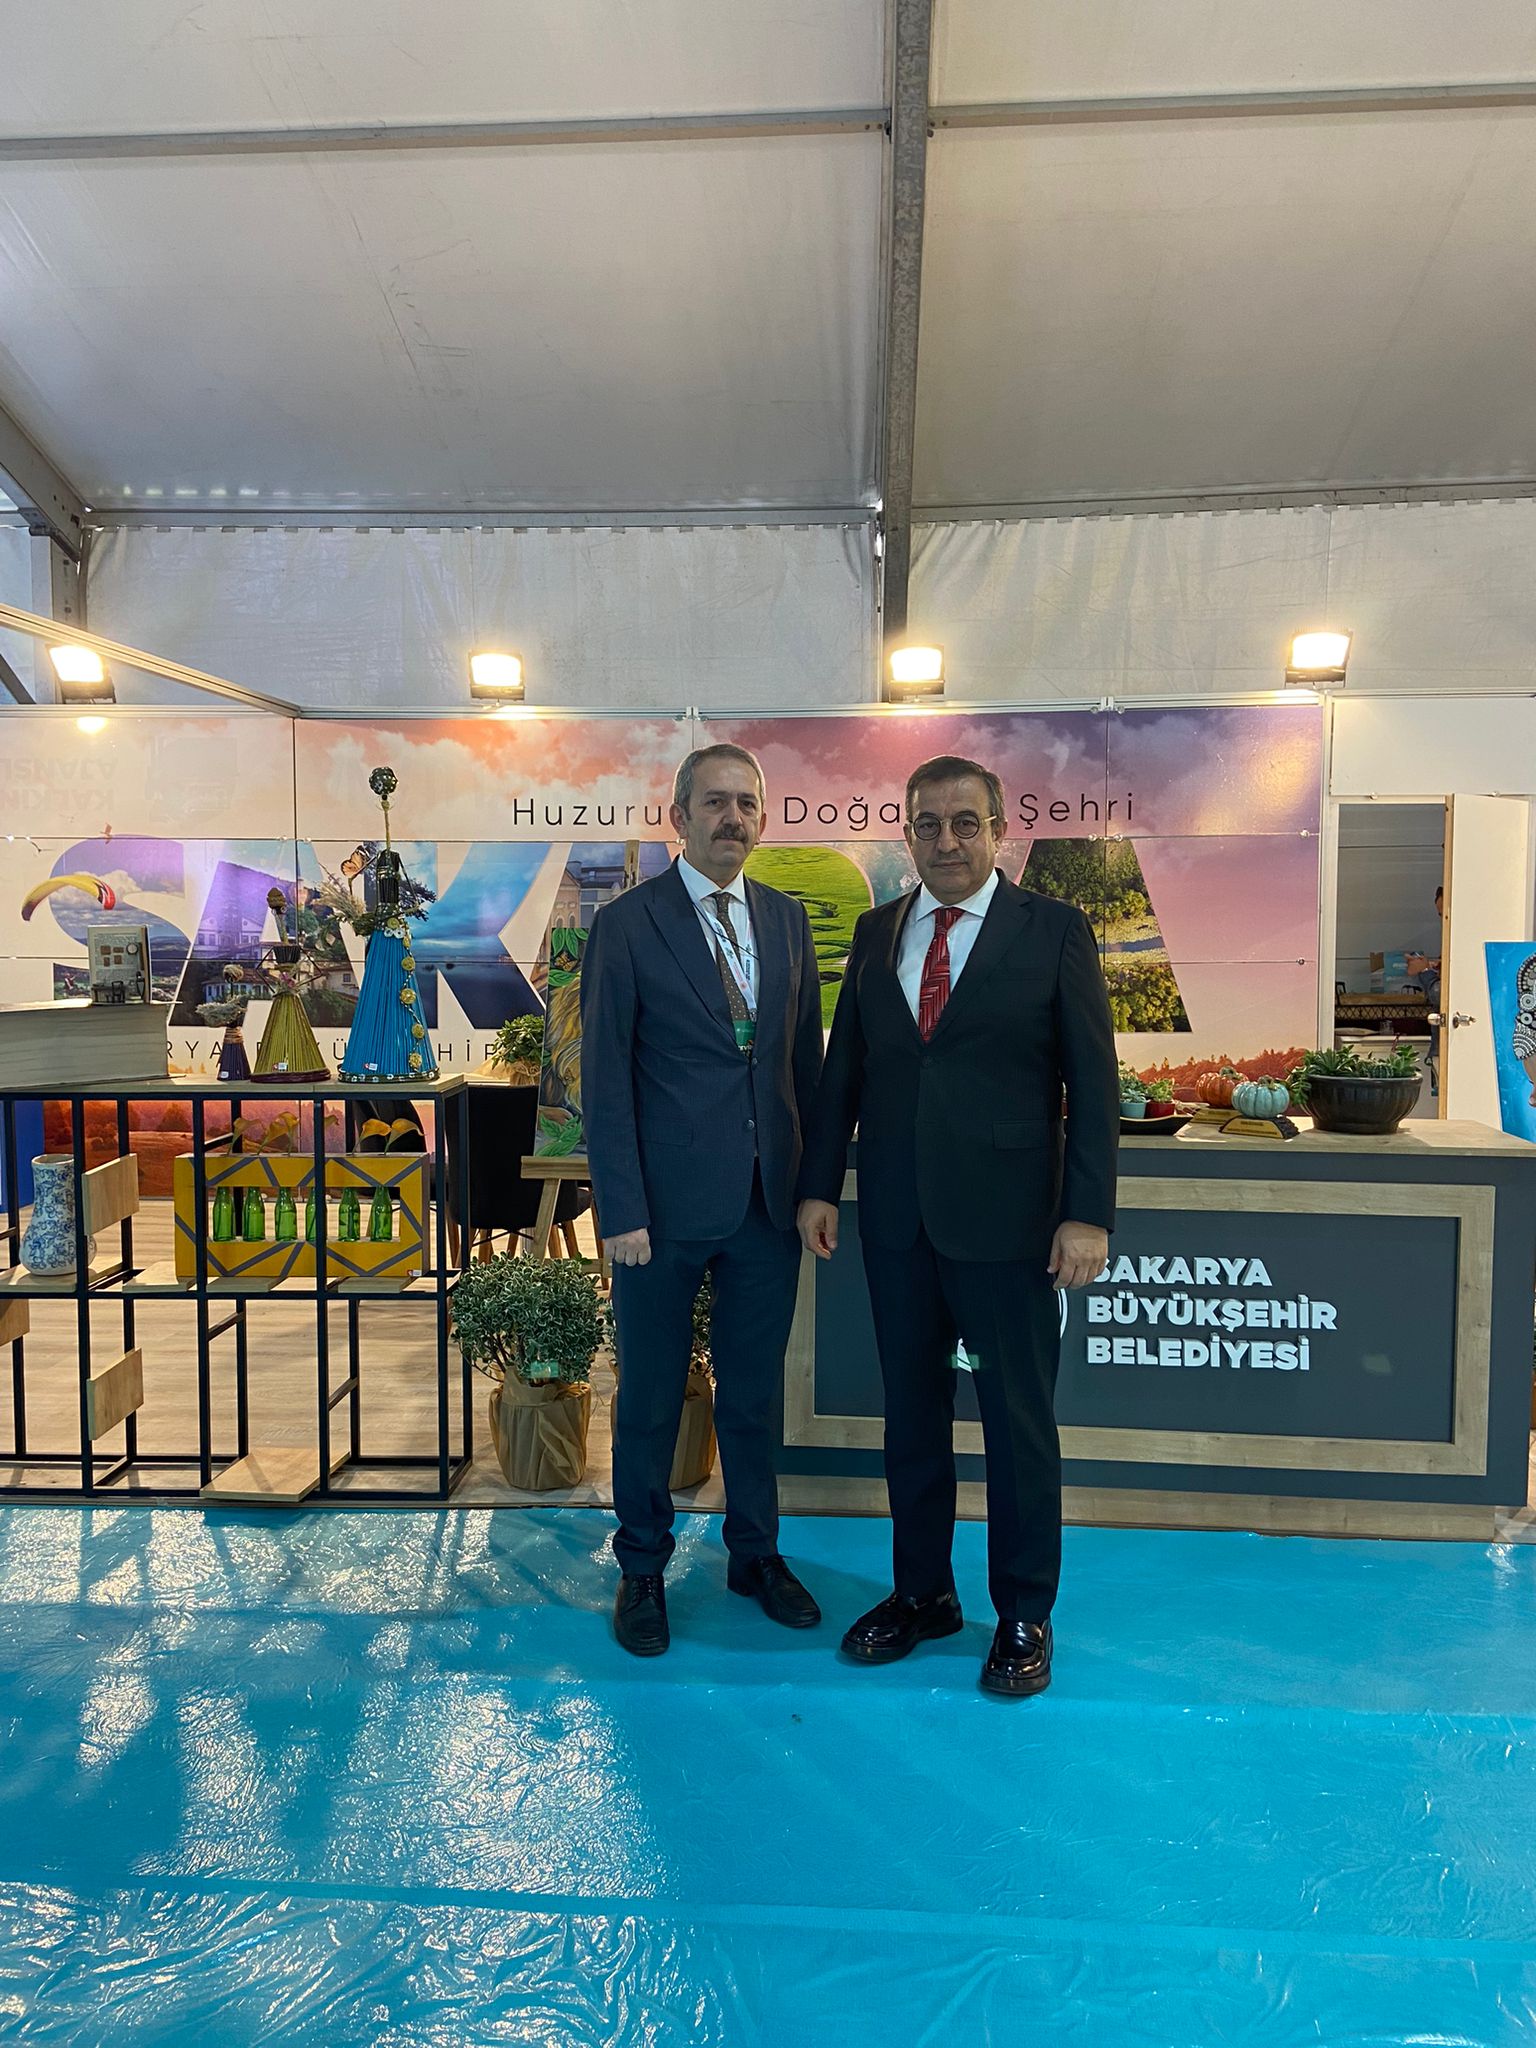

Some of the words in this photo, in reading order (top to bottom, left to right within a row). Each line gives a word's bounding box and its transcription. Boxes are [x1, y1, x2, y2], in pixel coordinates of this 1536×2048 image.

[1018, 792, 1133, 831] Şehri
[1086, 1289, 1338, 1334] BÜYÜKŞEHİR
[1086, 1332, 1311, 1372] BELEDİYESİ
